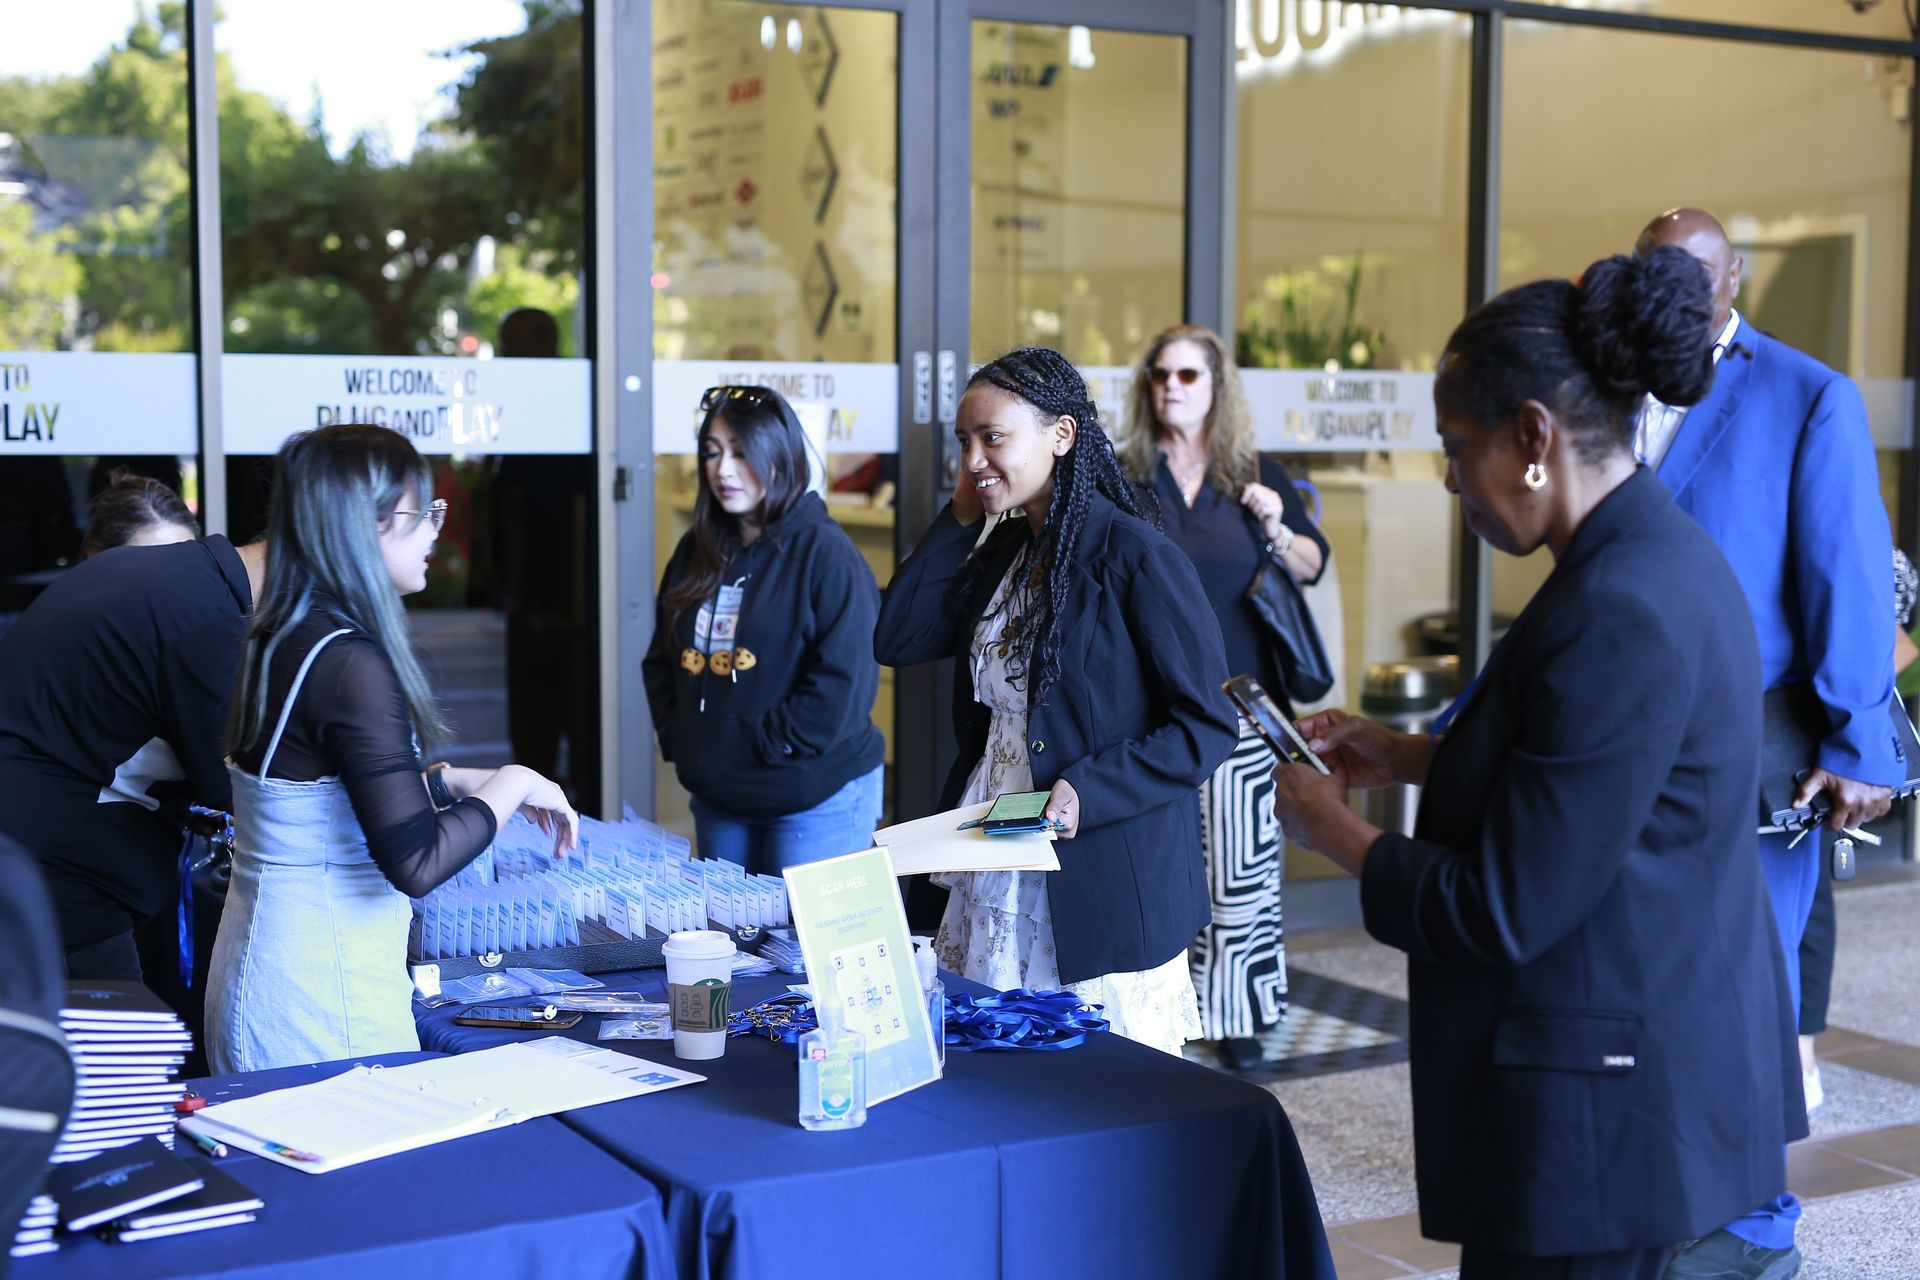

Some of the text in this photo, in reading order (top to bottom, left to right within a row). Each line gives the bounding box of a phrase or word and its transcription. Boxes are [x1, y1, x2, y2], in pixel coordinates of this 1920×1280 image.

[0, 363, 29, 393] TO
[344, 368, 445, 395] WELCOME
[813, 374, 835, 398] TO
[0, 402, 60, 441] LAY
[819, 874, 868, 897] SCAN HERE
